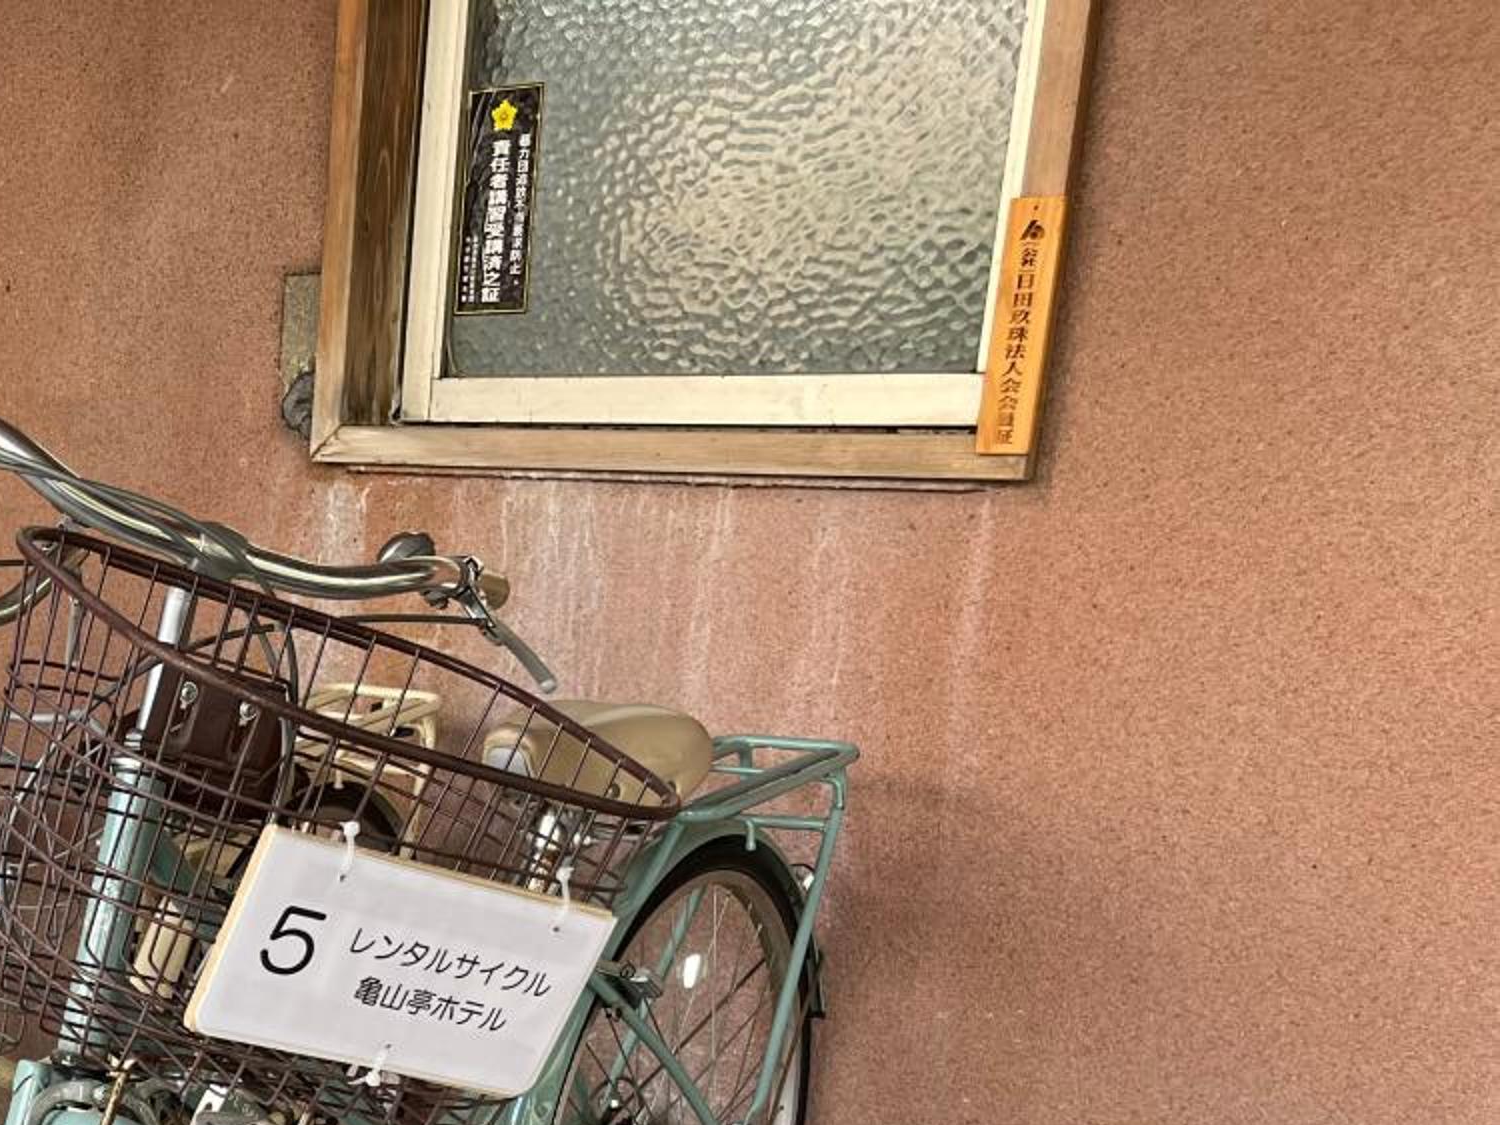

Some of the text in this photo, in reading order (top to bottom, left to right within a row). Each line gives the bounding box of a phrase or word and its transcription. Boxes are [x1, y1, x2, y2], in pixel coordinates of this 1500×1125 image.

[259, 904, 328, 976] 5
[348, 926, 553, 999] レンタルサイクル
[352, 975, 508, 1033] 亀山亭ホテル
